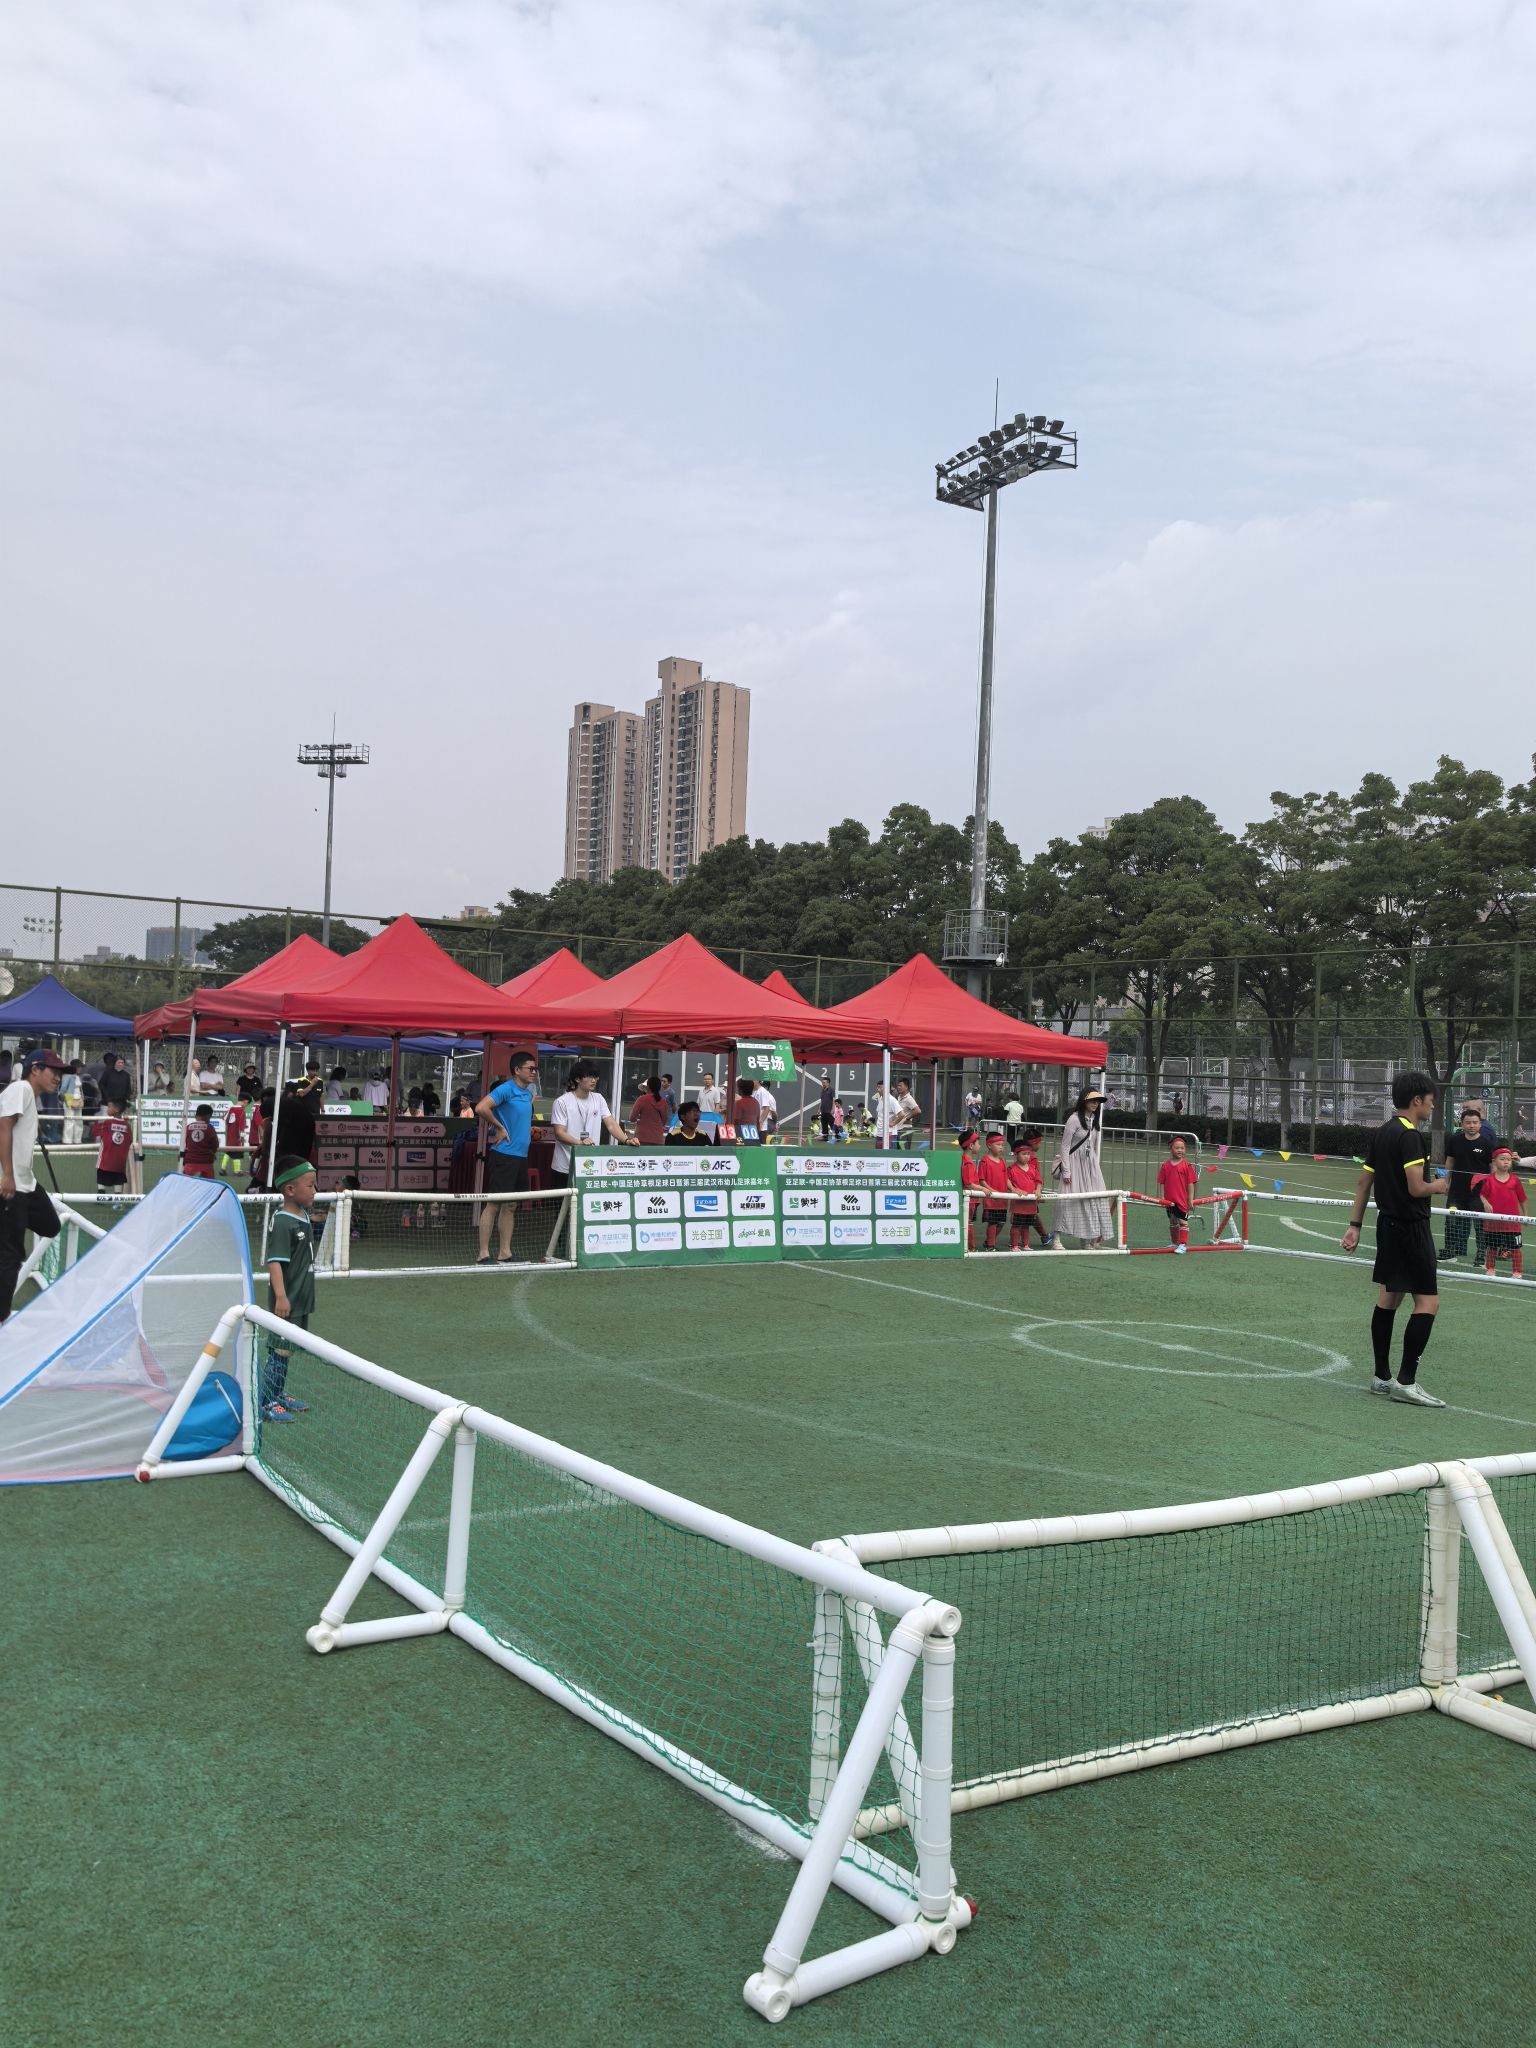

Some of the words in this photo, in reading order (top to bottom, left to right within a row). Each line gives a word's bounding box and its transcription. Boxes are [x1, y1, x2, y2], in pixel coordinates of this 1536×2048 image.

[697, 1063, 704, 1074] 5
[747, 1055, 785, 1072] 8号场
[821, 1067, 828, 1077] 2
[849, 1070, 855, 1080] 5
[742, 1125, 758, 1140] 00
[712, 1160, 732, 1170] AFC
[901, 1162, 920, 1172] AFC
[602, 1200, 623, 1212] 蒙牛
[800, 1197, 818, 1208] 蒙牛
[647, 1206, 669, 1214] Busu
[691, 1229, 723, 1241] 光合王国
[881, 1226, 911, 1237] 光合王国
